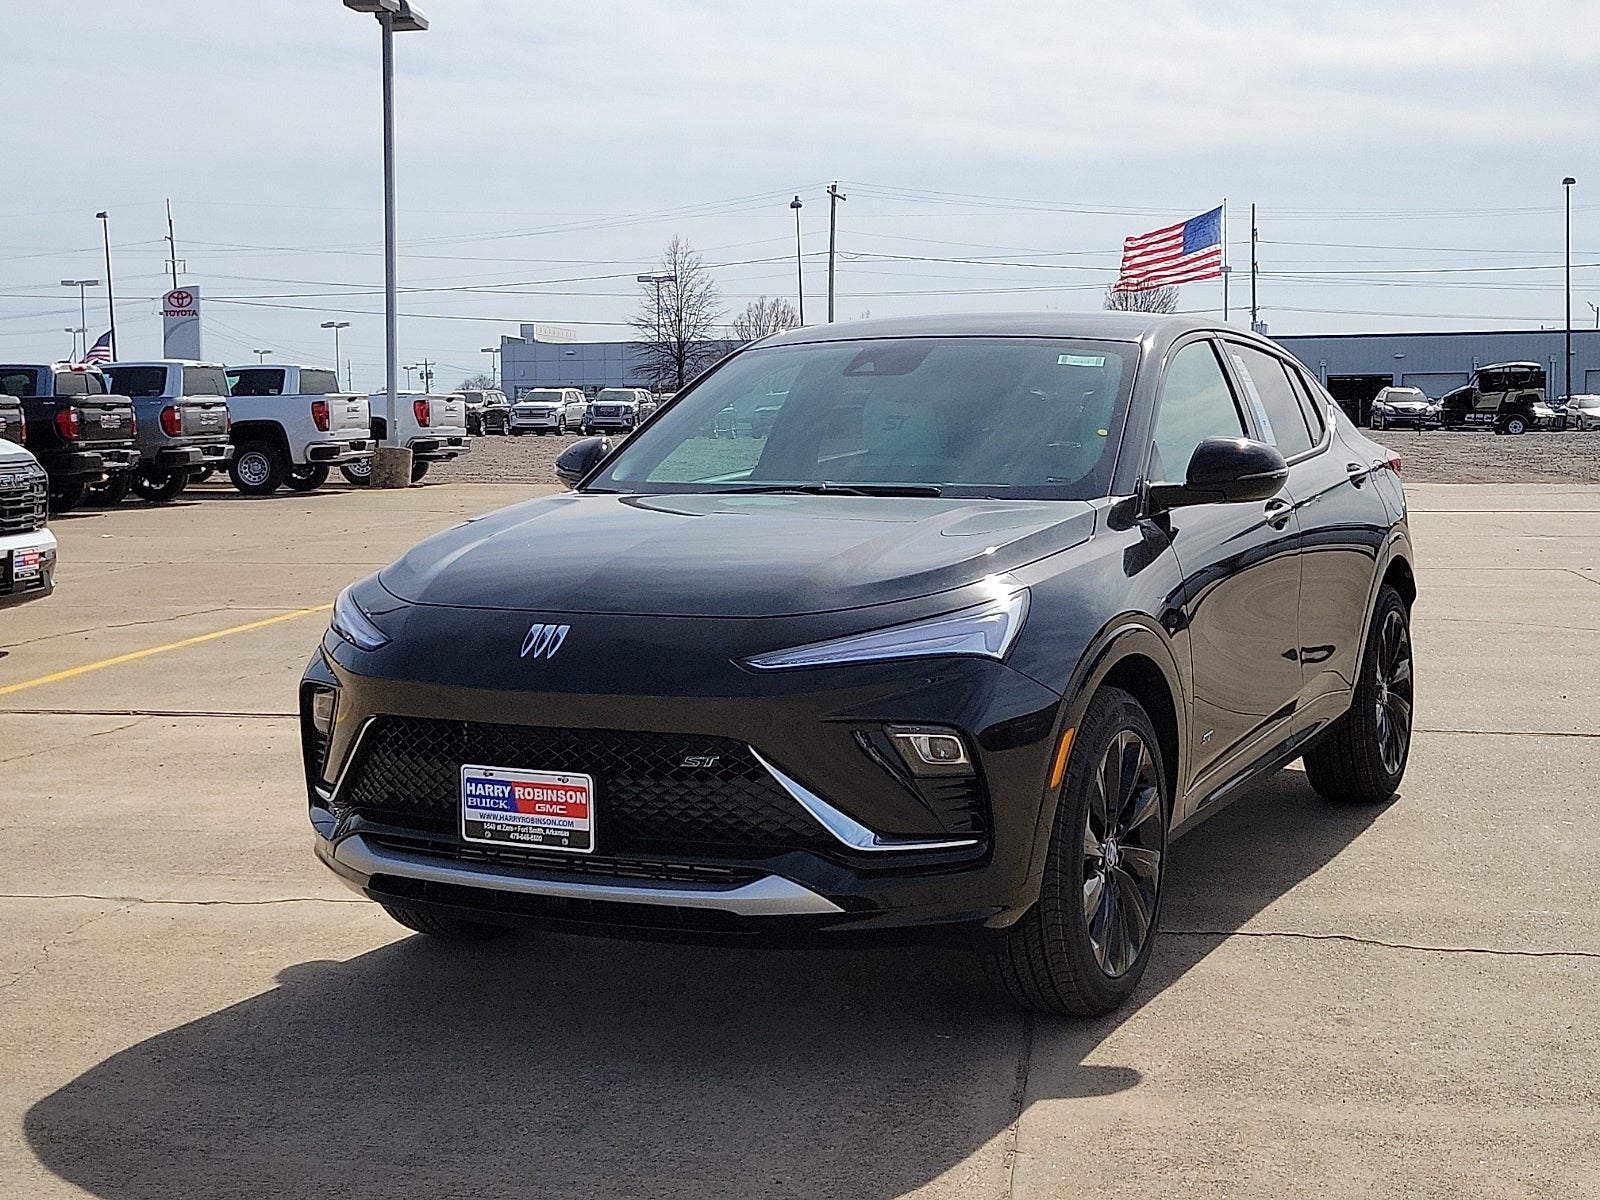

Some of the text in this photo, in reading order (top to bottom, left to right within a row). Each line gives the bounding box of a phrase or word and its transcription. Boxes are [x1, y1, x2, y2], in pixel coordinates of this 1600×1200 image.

[680, 756, 720, 767] ST
[467, 782, 587, 804] HARRY ROBINSON
[468, 797, 568, 814] BUICK GMC
[479, 812, 575, 828] WWW.HARRYROBINSON.COM
[517, 825, 529, 834] Fort
[545, 828, 570, 837] Arkansas
